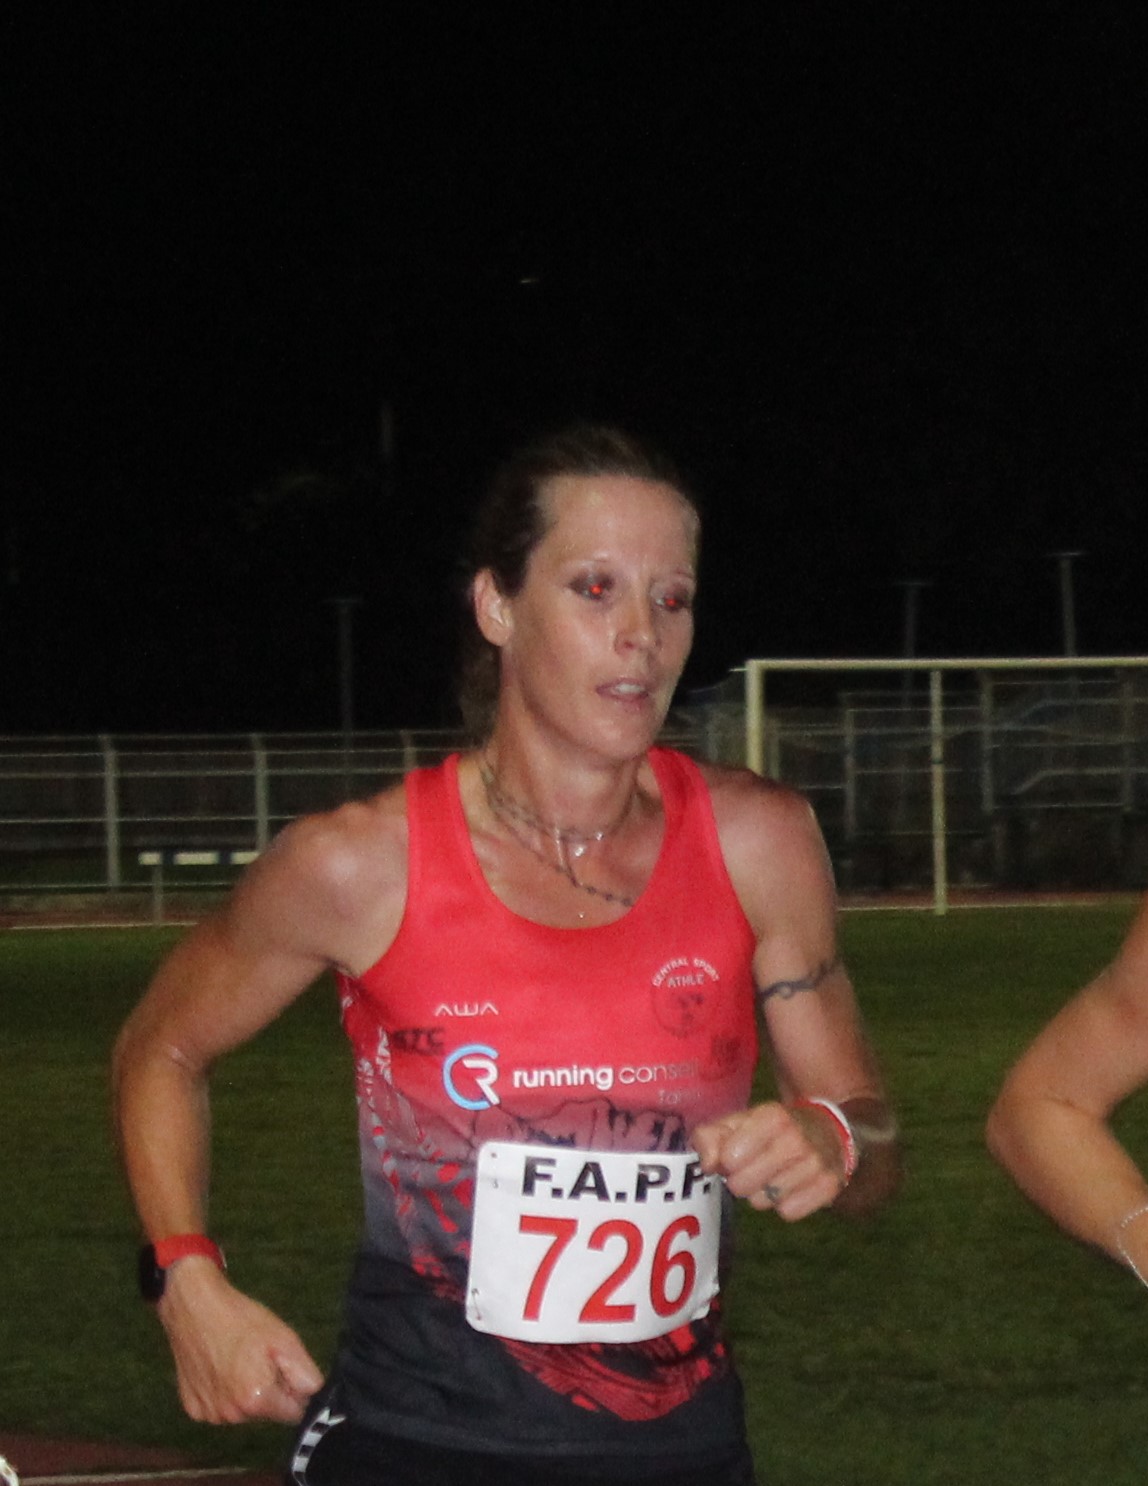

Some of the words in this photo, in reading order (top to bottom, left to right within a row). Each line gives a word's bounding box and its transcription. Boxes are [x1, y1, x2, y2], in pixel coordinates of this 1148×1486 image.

[652, 957, 688, 987] CENTRAL
[693, 958, 720, 982] SPORT
[512, 1064, 614, 1091] running
[519, 1214, 702, 1324] 726
